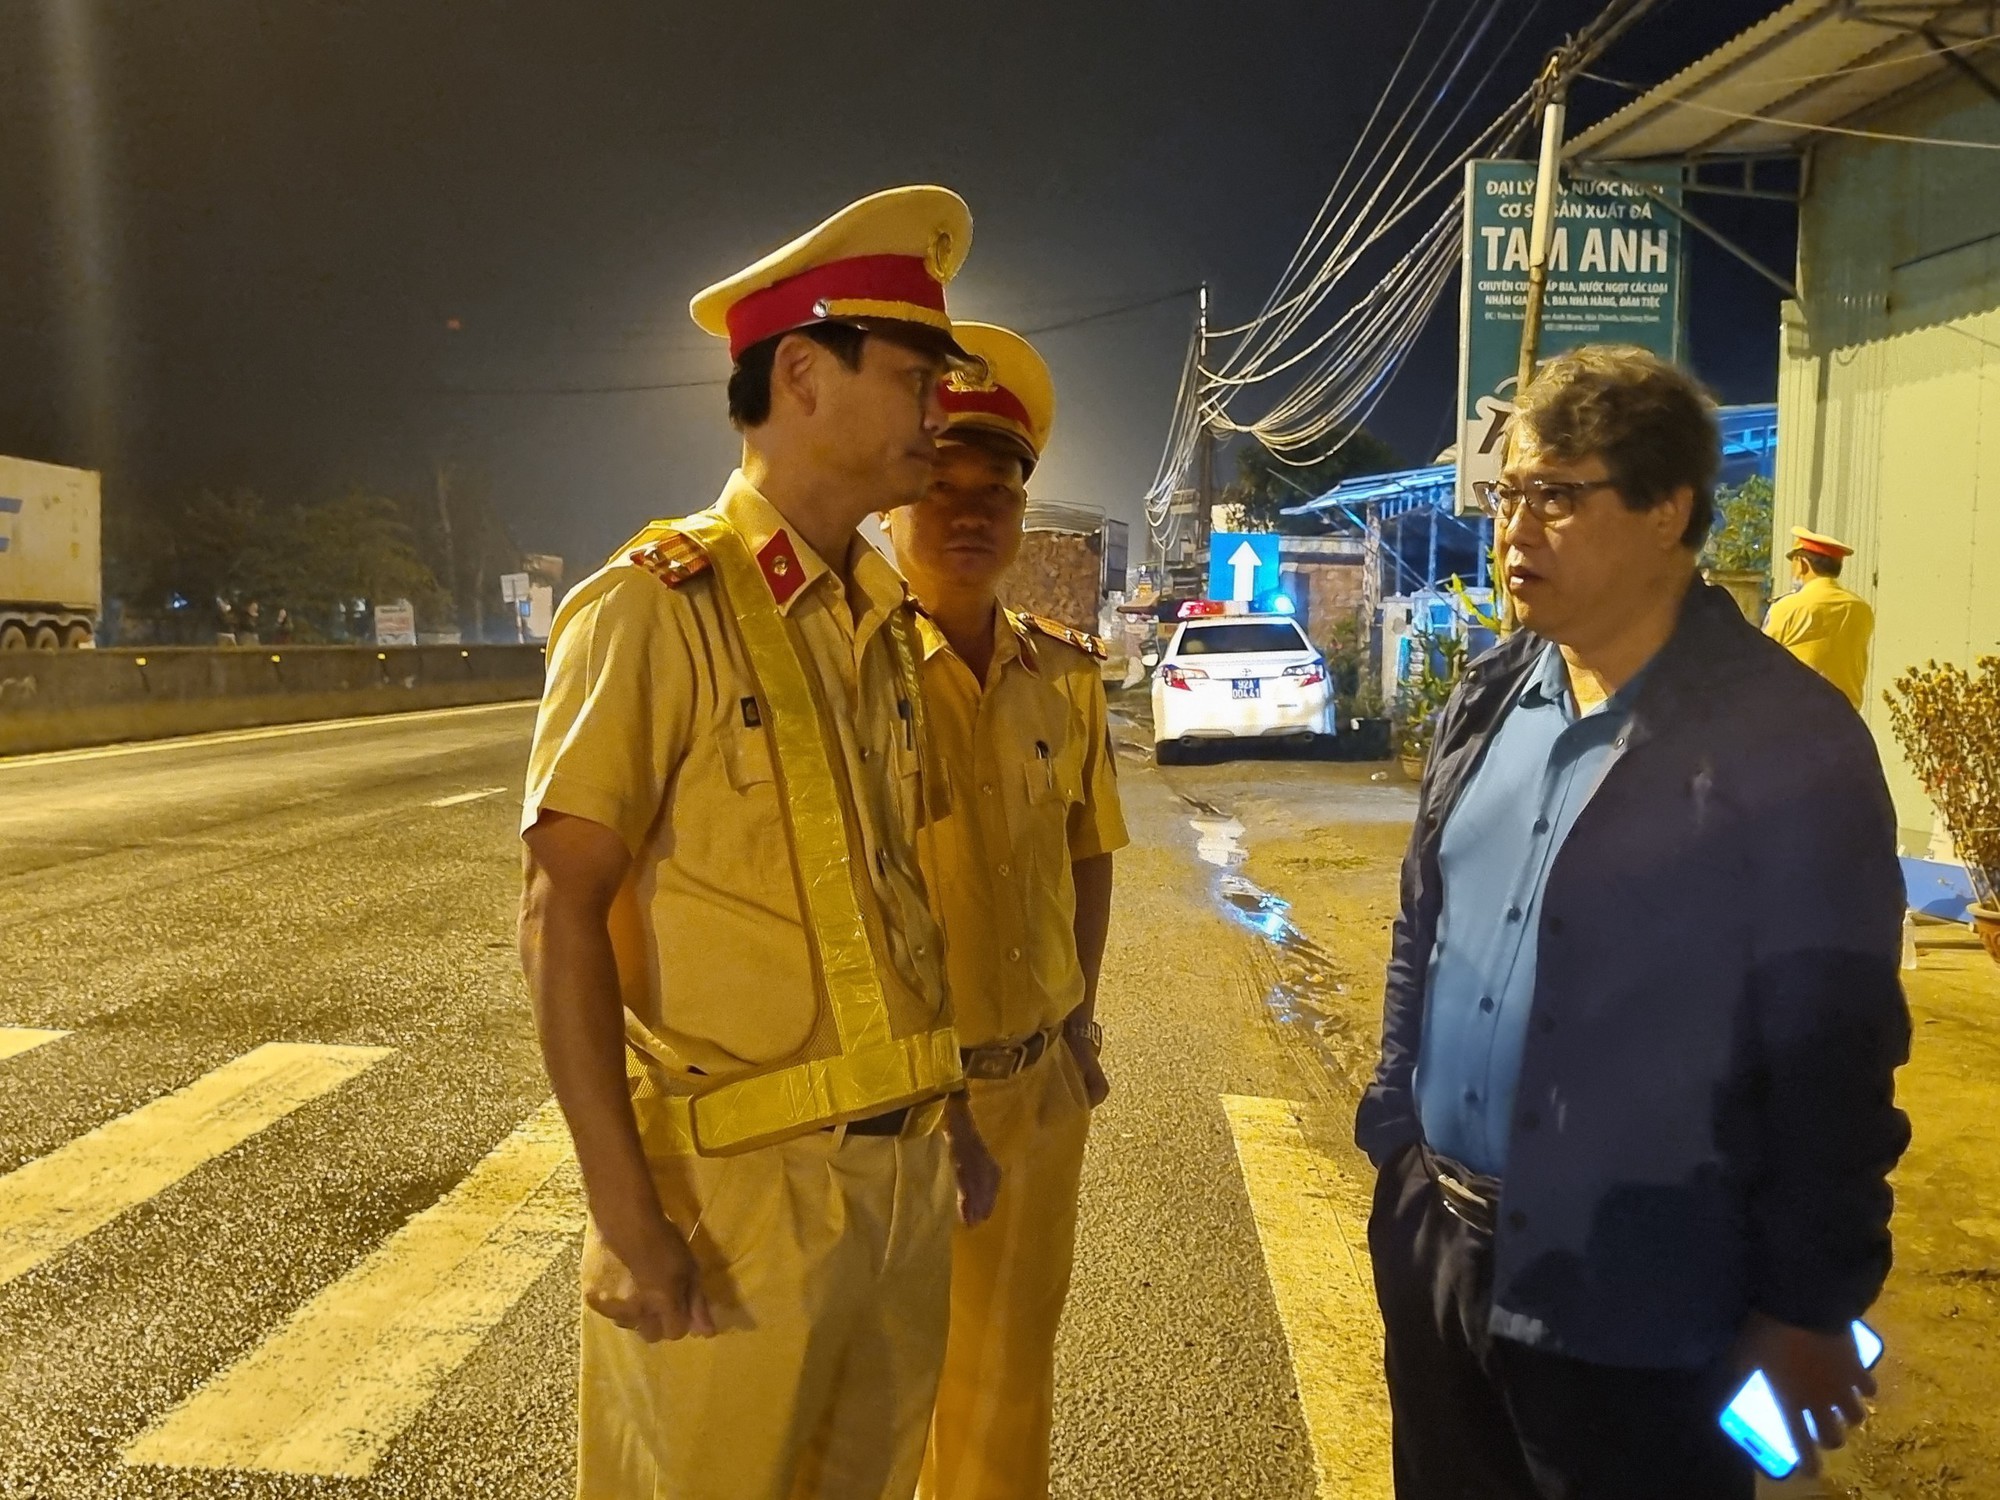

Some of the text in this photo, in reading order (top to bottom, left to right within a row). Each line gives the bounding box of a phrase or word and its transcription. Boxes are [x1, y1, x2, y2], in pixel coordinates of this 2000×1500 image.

[1486, 180, 1514, 198] ĐẠI
[1499, 201, 1522, 218] CƠ
[1629, 201, 1653, 220] ĐÁ
[1578, 227, 1669, 274] ANH
[1478, 279, 1513, 292] CHUYÊN
[1579, 280, 1604, 293] NƯỚC
[1630, 282, 1647, 293] CÁC
